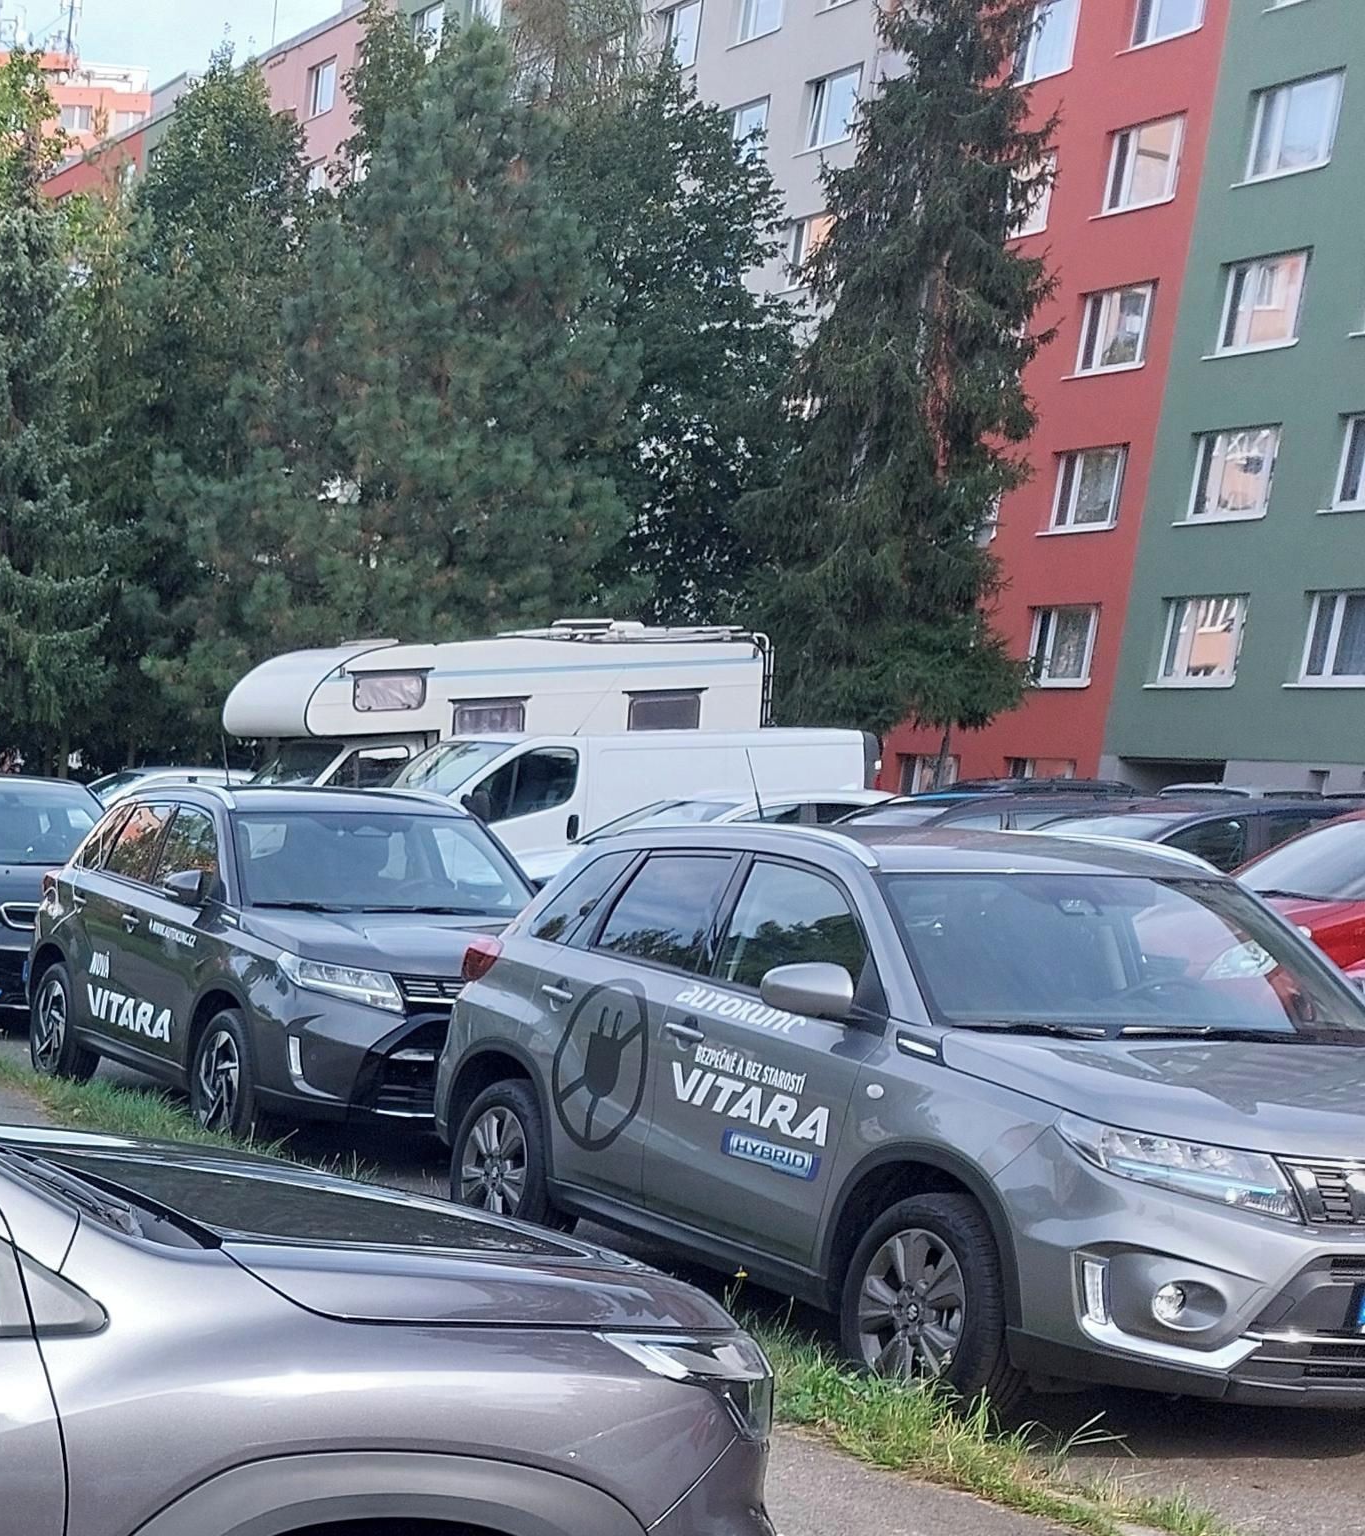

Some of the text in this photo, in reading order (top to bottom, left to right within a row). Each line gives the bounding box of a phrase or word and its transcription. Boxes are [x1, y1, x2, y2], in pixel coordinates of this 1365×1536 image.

[88, 950, 110, 979] NOVÁ
[87, 983, 172, 1043] VITARA
[694, 1044, 737, 1075] BEZPEČNĚ
[744, 1062, 763, 1082] BEZ
[762, 1066, 808, 1096] STAROSTÍ
[672, 1061, 830, 1147] VITARA
[734, 1137, 806, 1169] HYBRID
